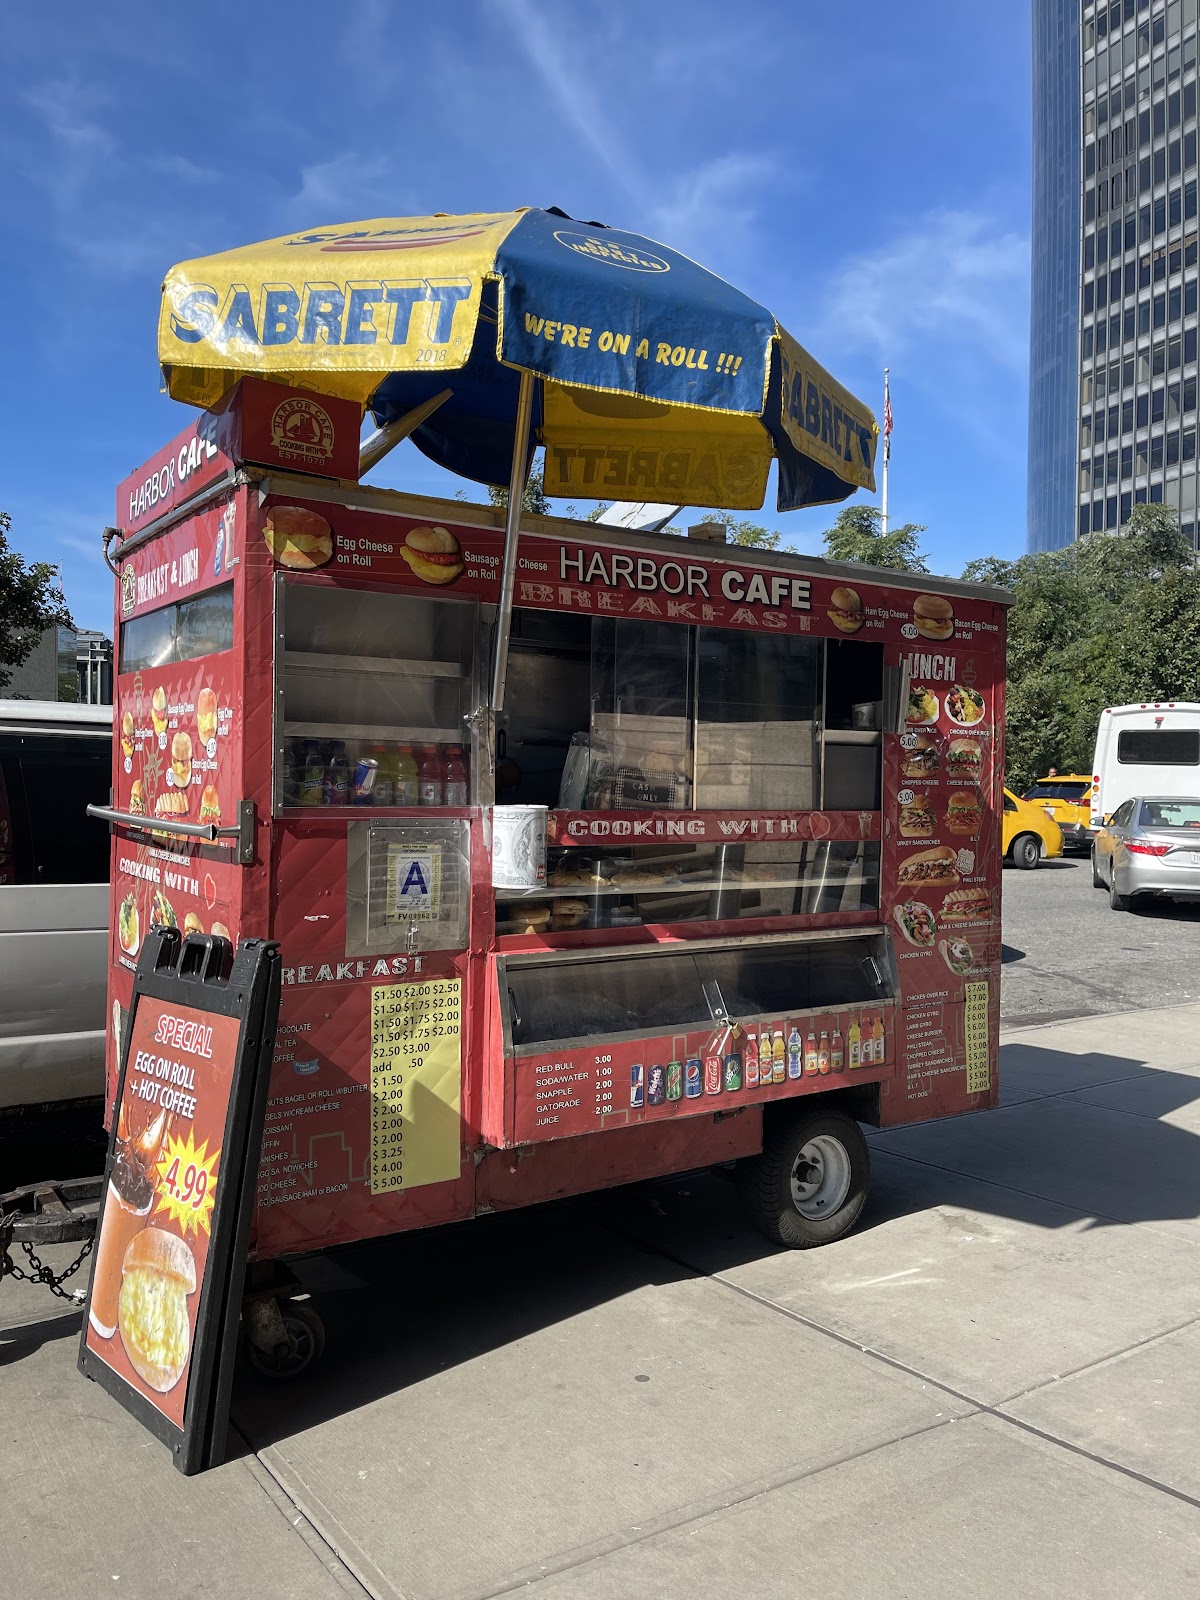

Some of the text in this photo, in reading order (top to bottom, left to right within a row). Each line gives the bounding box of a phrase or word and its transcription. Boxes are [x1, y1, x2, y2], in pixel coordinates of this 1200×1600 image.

[170, 277, 472, 346] SABRETT
[524, 311, 743, 376] WE'RE ON A ROLL !!!
[416, 349, 446, 362] 2018
[274, 401, 332, 439] HARBOR CAFE
[279, 439, 319, 455] COOKING WITH
[129, 418, 218, 520] HARBOR CAFE
[336, 535, 394, 553] Egg Cheese
[337, 552, 372, 567] on Roll
[464, 551, 548, 571] Sausage Cheese
[137, 562, 169, 605] BREAKFAST
[170, 560, 178, 585] &
[178, 548, 199, 588] LUNCH
[467, 568, 496, 580] on Roll
[559, 546, 812, 609] HARBOR CAFE
[519, 582, 820, 631] BREAKFAST
[865, 606, 909, 619] Ham Egg Cheese
[874, 620, 885, 629] Roll
[902, 626, 918, 636] 5.00
[955, 619, 998, 632] Bacon Egg Cheese
[962, 632, 972, 640] Roll
[901, 737, 916, 747] 5.00
[632, 782, 656, 791] CASH
[637, 793, 659, 802] ONLY
[899, 792, 914, 802] 5.00
[567, 819, 798, 837] COOKING WITH
[119, 857, 161, 884] COOKING
[164, 871, 199, 896] WITH
[401, 862, 428, 894] A
[281, 955, 427, 986] REAKFAST
[374, 983, 458, 1001] $1.50 $2.00 $2.50
[374, 998, 458, 1015] $1.50 $1.75 $2.00
[374, 1011, 458, 1030] $1.50 $1.75 $2.00
[276, 1023, 312, 1034] HOCOLATE
[374, 1026, 458, 1044] $1.50 $1.75 $2.00
[154, 1013, 213, 1058] SPECIAL
[284, 1039, 296, 1047] TEA
[852, 1043, 859, 1054] G
[864, 1041, 871, 1051] G
[374, 1043, 430, 1059] $2.50 $3.00
[907, 1048, 945, 1060] CHOPPED CHEESE
[272, 1053, 295, 1063] OFFEE
[595, 1054, 612, 1064] 3.00
[925, 1057, 954, 1066] SANDWICHES
[134, 1050, 195, 1091] EGG ON ROLL
[373, 1058, 422, 1072] add .50
[536, 1061, 575, 1074] RED BULL
[595, 1067, 612, 1077] 1.00
[922, 1069, 940, 1077] CHEESE
[536, 1072, 589, 1087] SODA/WATER
[595, 1080, 613, 1090] 2.00
[130, 1078, 197, 1119] + HOT COFFEE
[267, 1097, 283, 1107] NUTS
[285, 1094, 306, 1104] BAGEL
[307, 1092, 317, 1100] OR
[318, 1089, 334, 1098] ROLL
[536, 1087, 574, 1100] SNAPPLE
[595, 1092, 613, 1102] 2.00
[264, 1111, 281, 1121] GELS
[314, 1101, 341, 1112] CHEESE
[536, 1099, 581, 1113] GATORADE
[595, 1105, 613, 1115] 2.00
[536, 1115, 560, 1126] JUICE
[261, 1140, 280, 1150] UFFIN
[260, 1151, 289, 1164] ANISHES
[164, 1157, 209, 1211] 4.99
[270, 1178, 297, 1190] CHEESE
[326, 1183, 348, 1194] BACON
